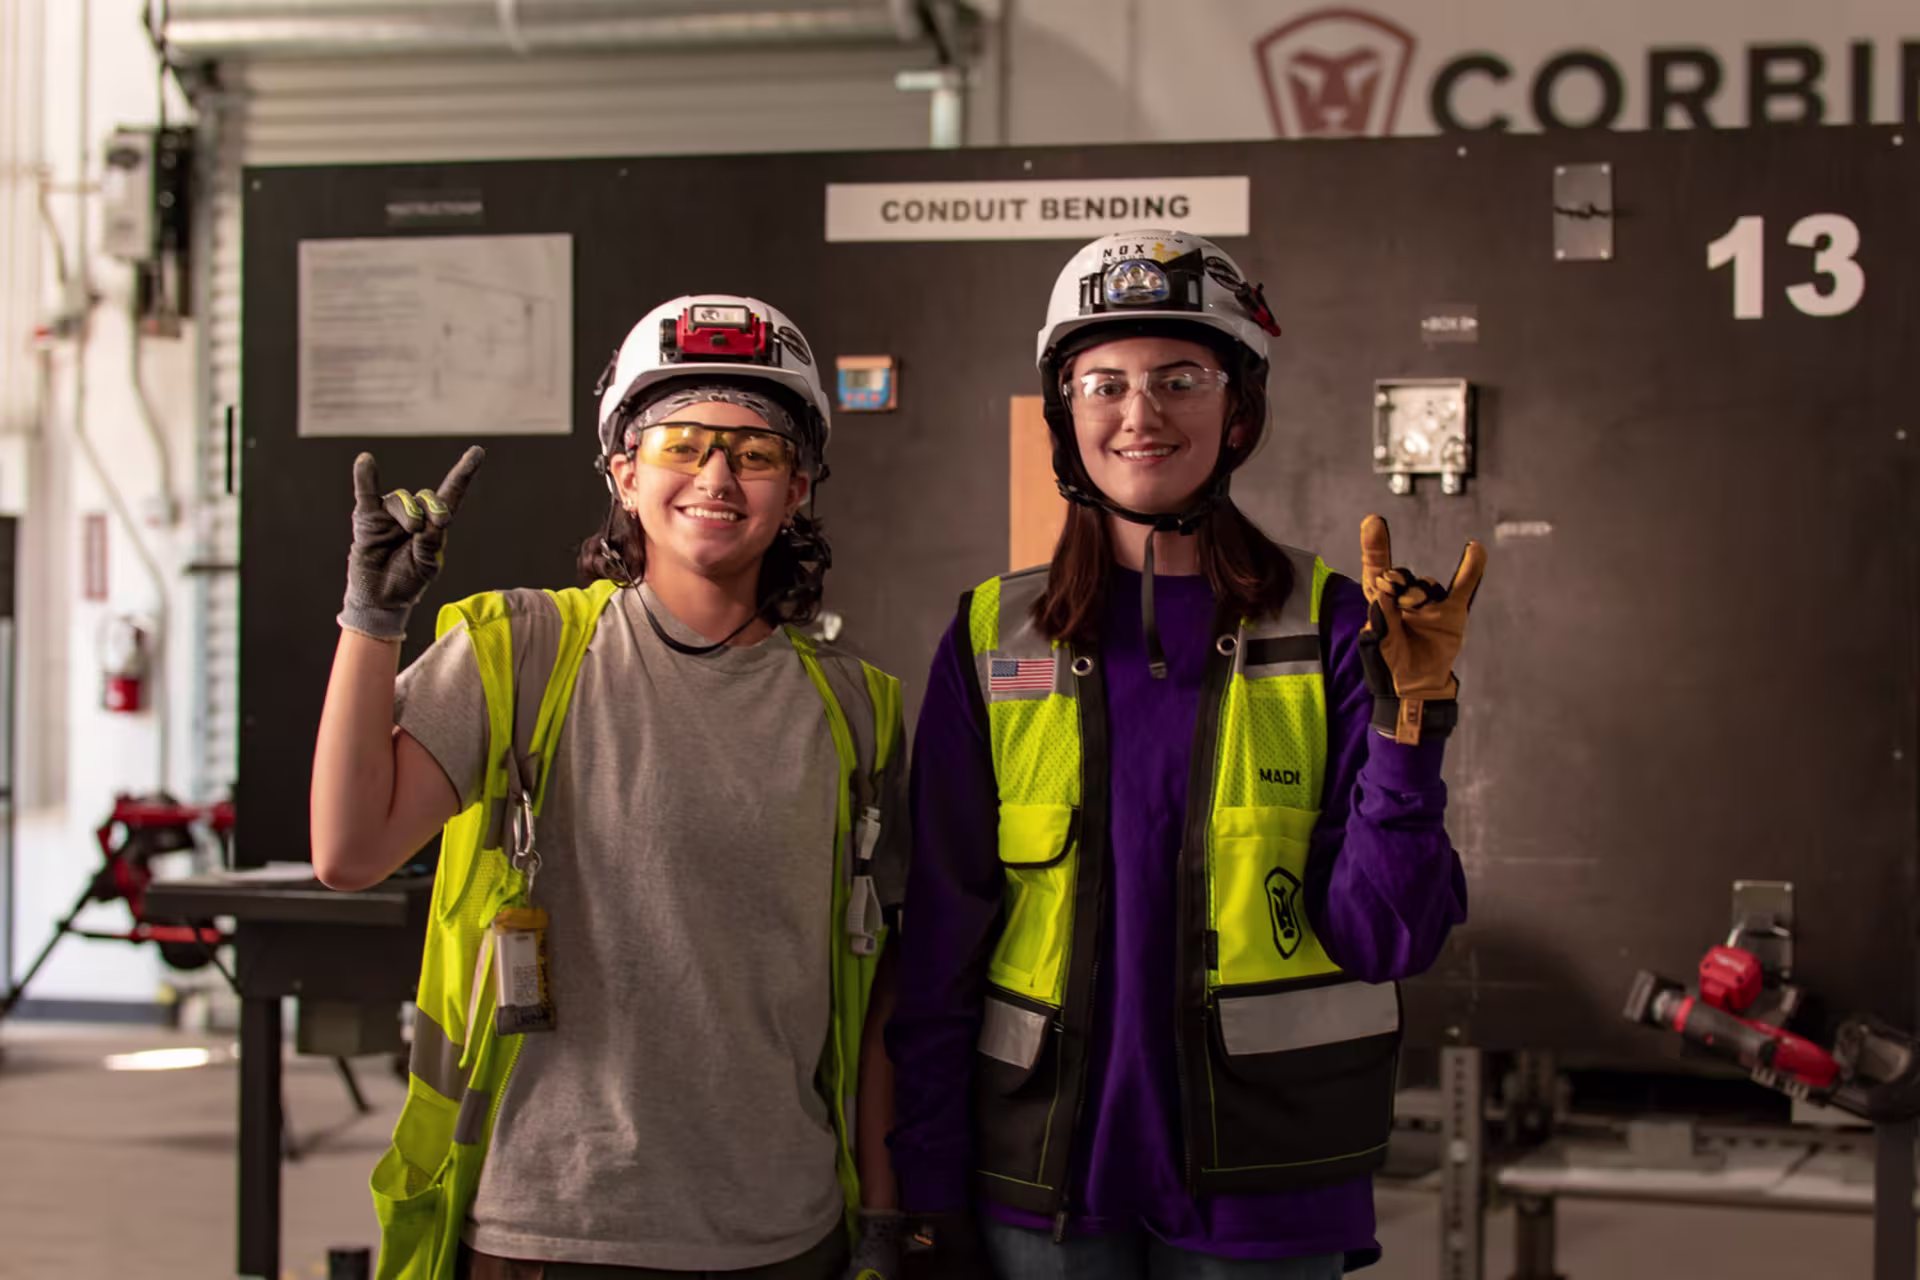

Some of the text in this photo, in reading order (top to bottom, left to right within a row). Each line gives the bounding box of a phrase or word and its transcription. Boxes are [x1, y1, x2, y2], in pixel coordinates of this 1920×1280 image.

[880, 195, 1191, 223] CONDUIT BENDING
[1103, 243, 1145, 258] NOX
[1707, 213, 1865, 319] 13
[1259, 768, 1301, 785] MADI
